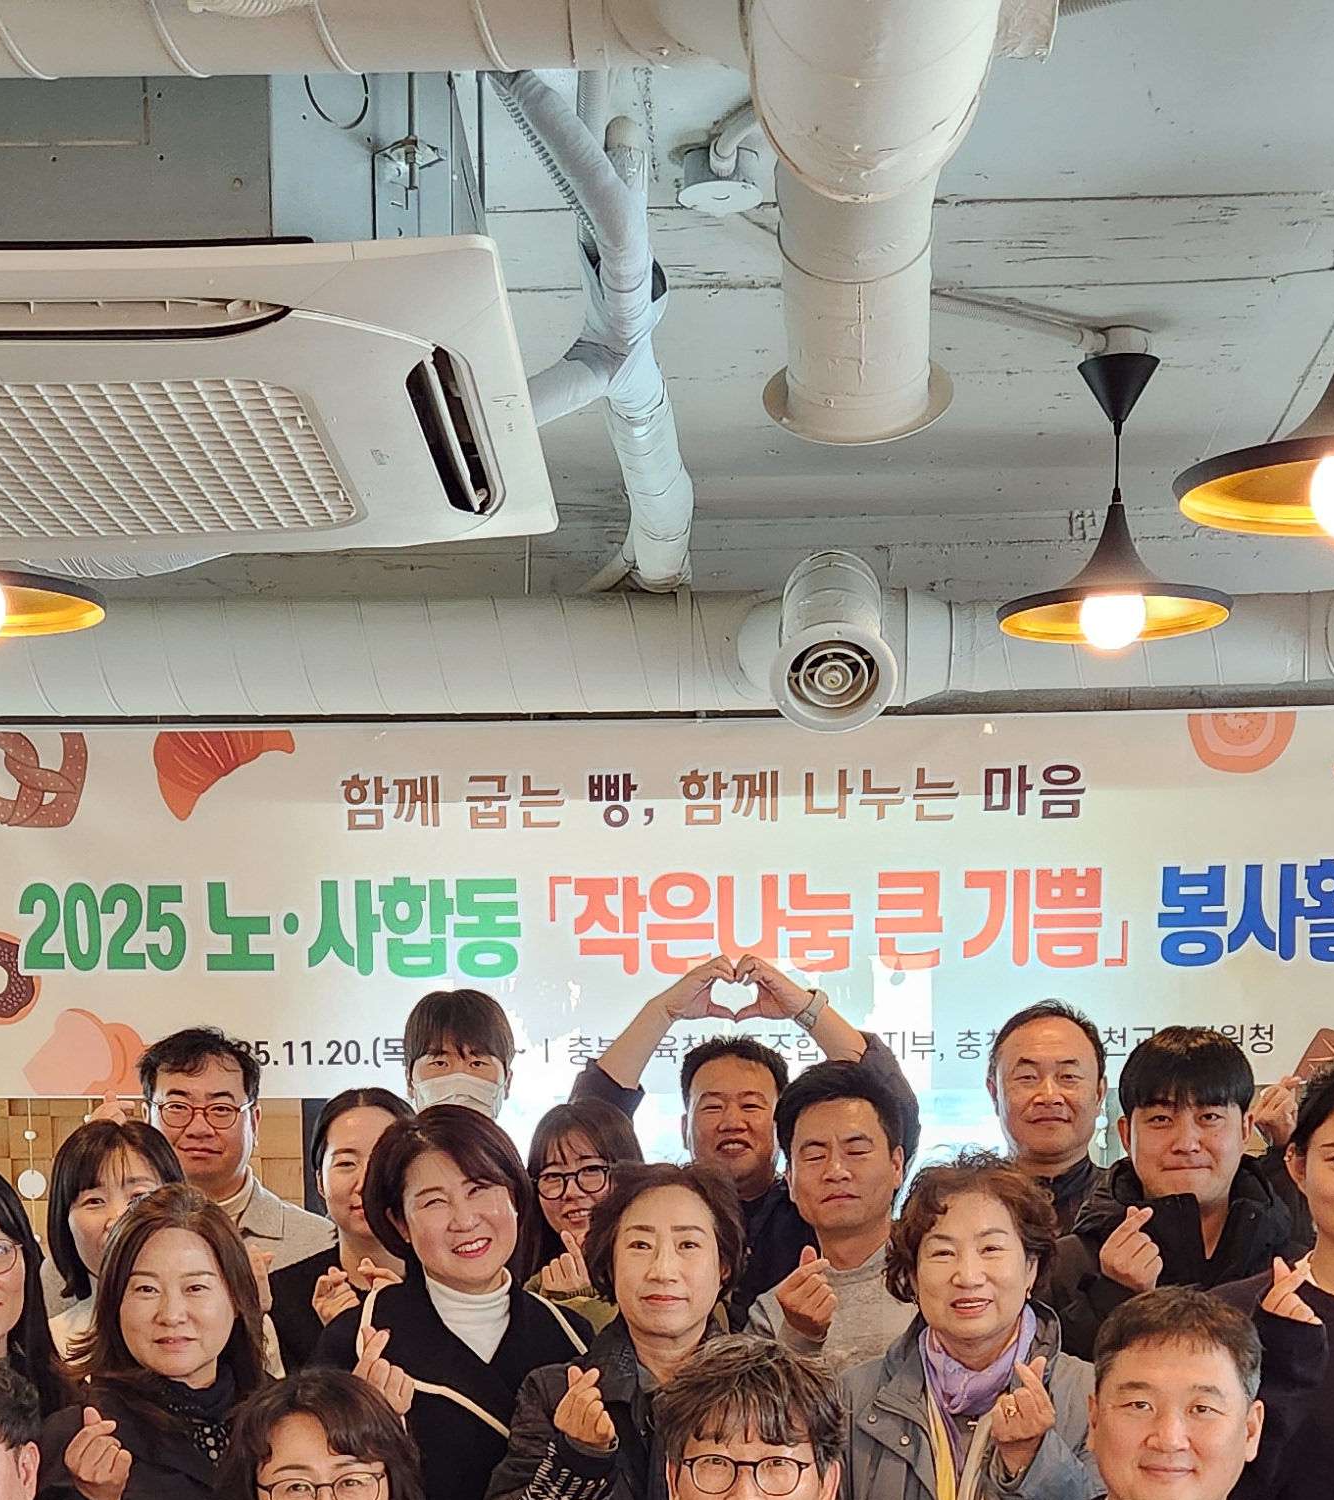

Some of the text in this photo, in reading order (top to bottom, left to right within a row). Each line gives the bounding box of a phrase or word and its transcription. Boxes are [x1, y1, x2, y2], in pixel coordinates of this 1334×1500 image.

[340, 763, 1086, 831] 함께 굽는 빵, 함께 나누는 마음
[18, 881, 187, 972] 2025
[873, 870, 944, 971] 큰
